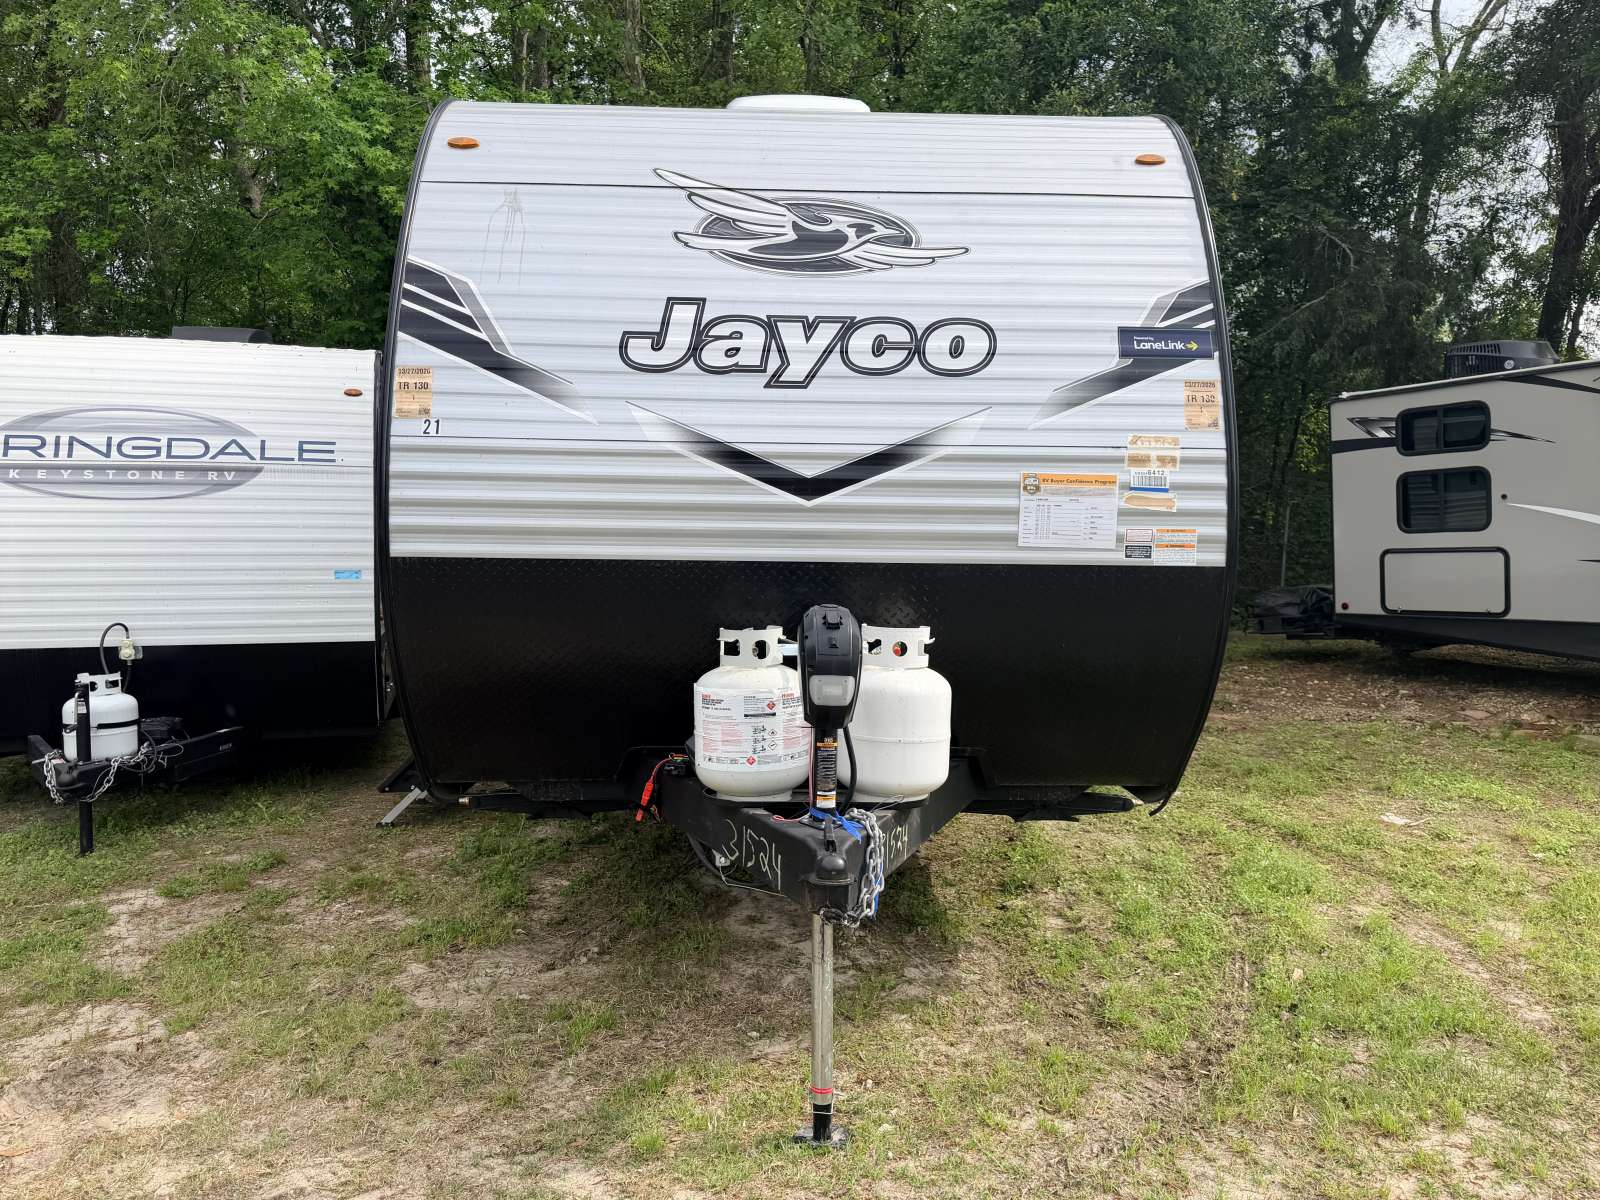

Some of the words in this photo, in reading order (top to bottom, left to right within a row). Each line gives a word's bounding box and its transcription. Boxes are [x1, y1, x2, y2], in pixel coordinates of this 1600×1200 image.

[619, 297, 997, 389] Jayco
[1134, 340, 1186, 350] LaneLink
[398, 382, 410, 390] TR
[414, 382, 429, 390] 130
[1186, 394, 1198, 402] TR
[423, 418, 440, 435] 21
[2, 434, 337, 463] RINGDALE
[9, 468, 186, 480] KEYSTONE
[208, 470, 236, 481] RV
[722, 819, 782, 891] 31524
